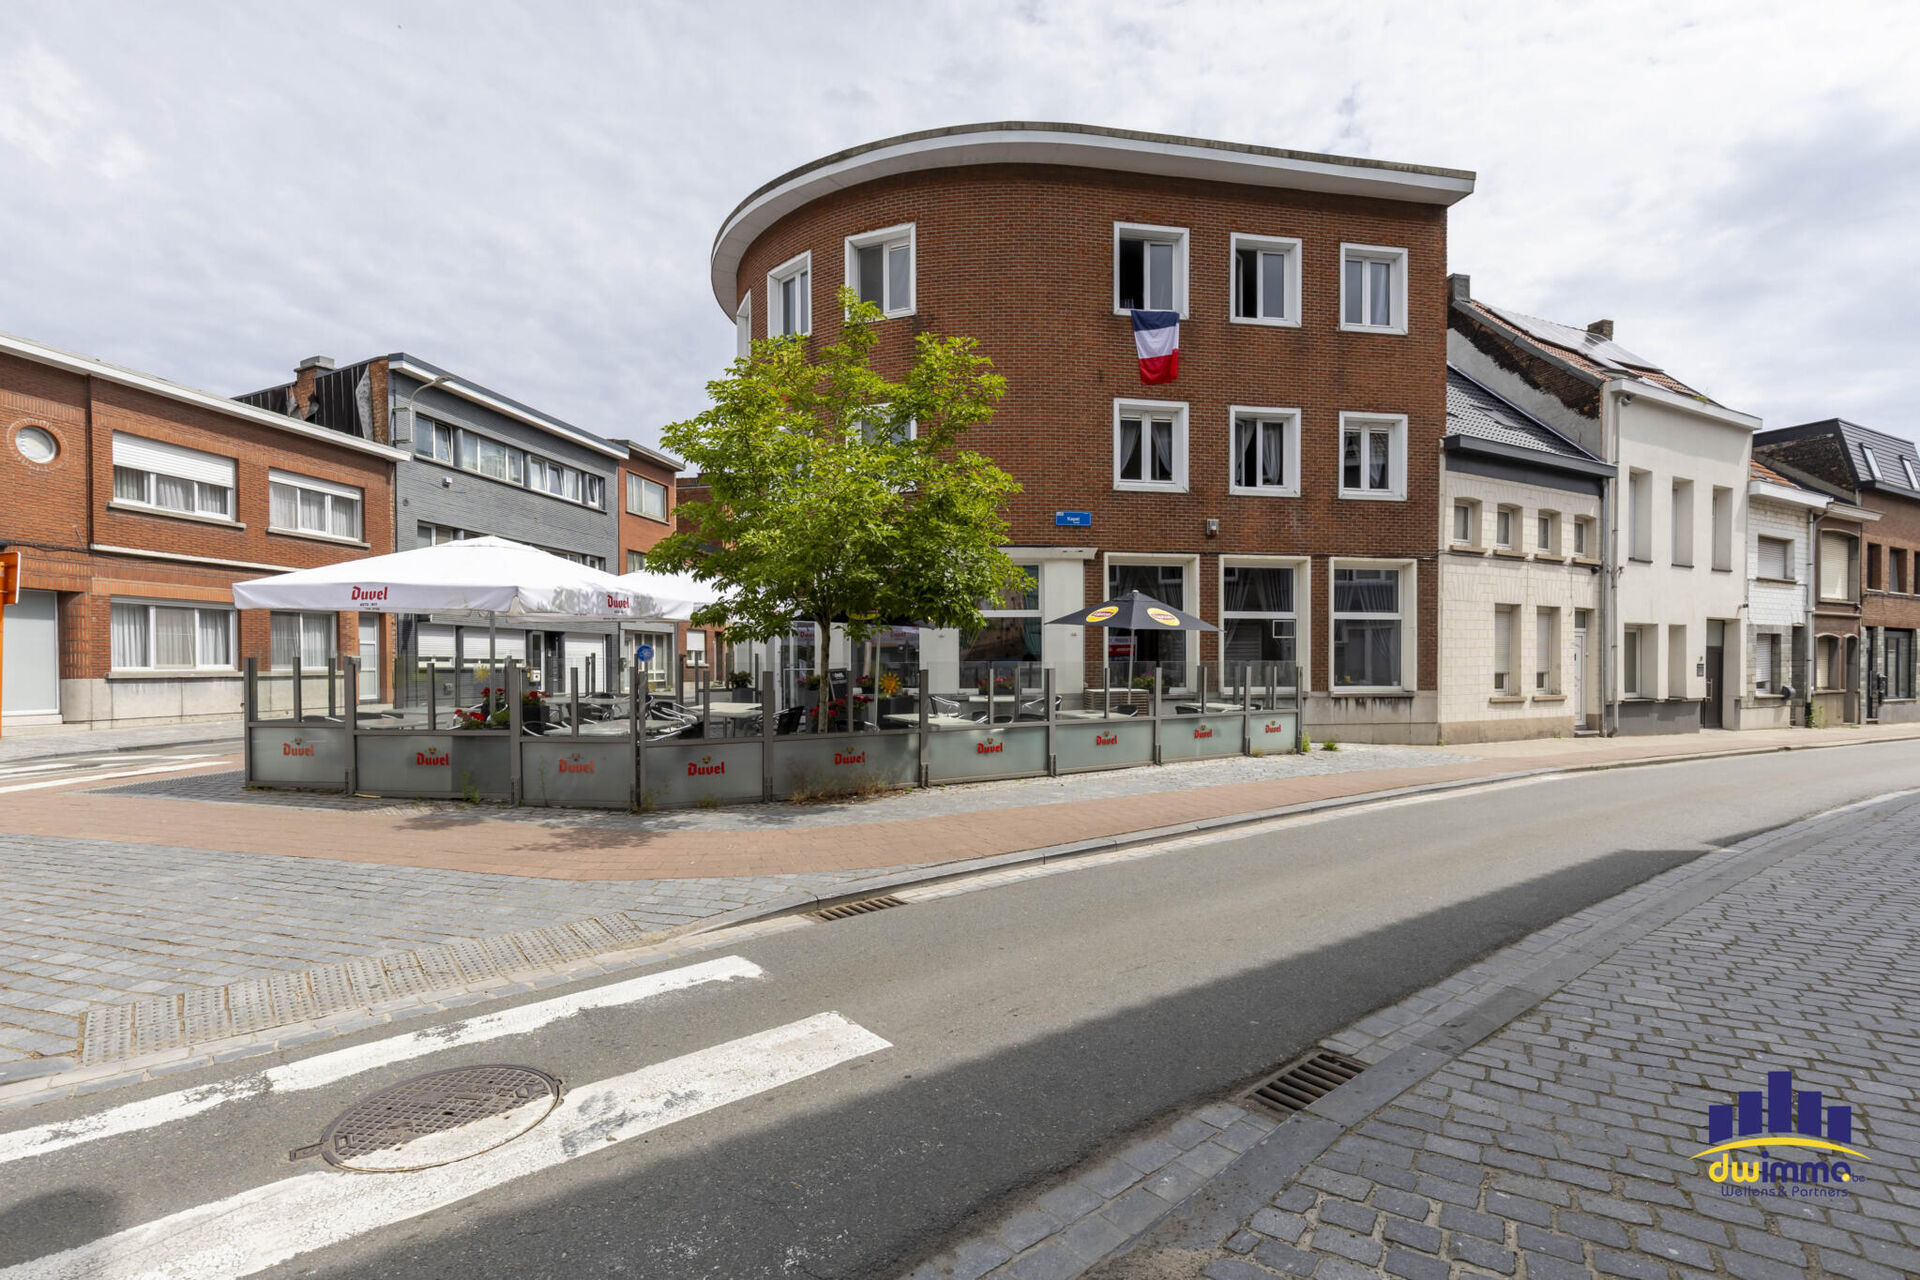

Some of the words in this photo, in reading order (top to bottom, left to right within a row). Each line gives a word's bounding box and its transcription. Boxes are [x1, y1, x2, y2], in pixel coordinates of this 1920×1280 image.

[351, 585, 388, 601] Duvel
[607, 594, 629, 609] Duvel
[1194, 728, 1213, 739] Duvel
[1265, 723, 1282, 734] Duvel
[1096, 735, 1117, 746] Duvel
[282, 743, 314, 757] Duvel
[977, 742, 1003, 754] Duvel
[416, 752, 449, 766] Duvel
[834, 751, 865, 765] Duvel
[558, 758, 594, 774] Duvel
[687, 761, 725, 777] Duvel
